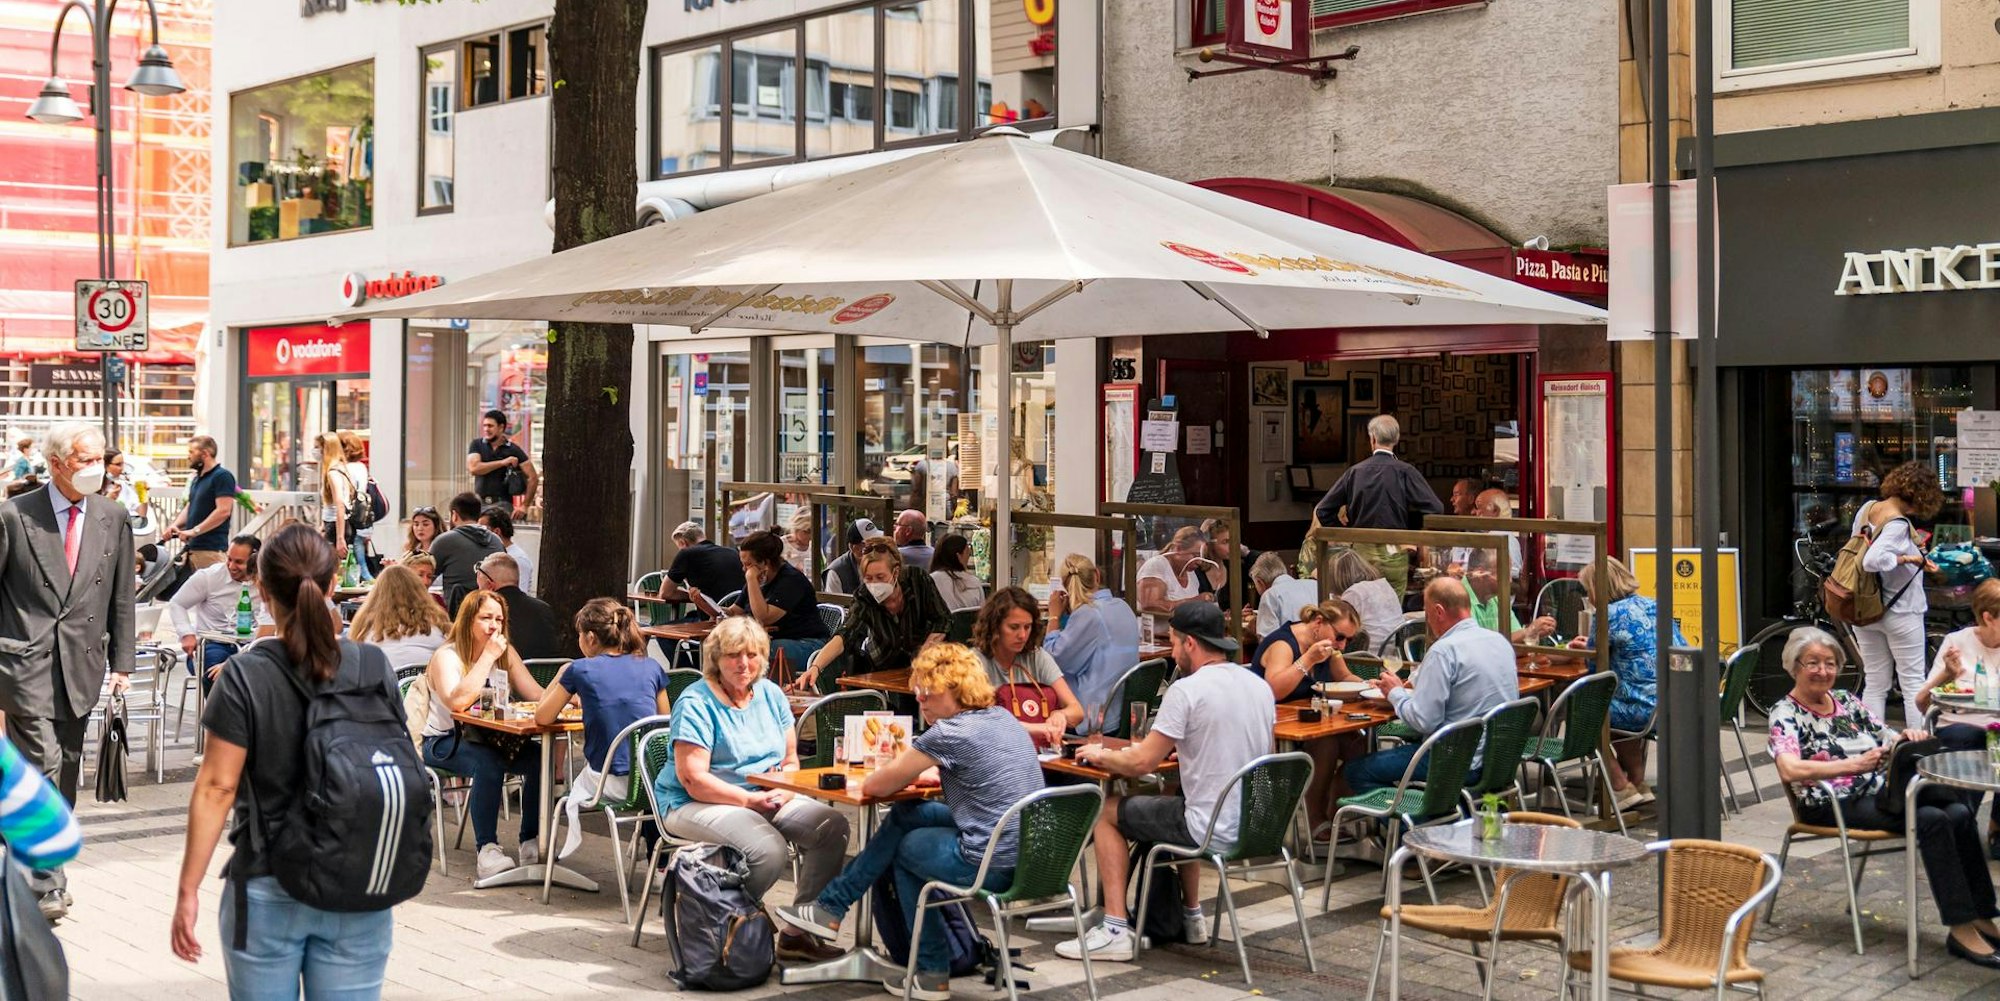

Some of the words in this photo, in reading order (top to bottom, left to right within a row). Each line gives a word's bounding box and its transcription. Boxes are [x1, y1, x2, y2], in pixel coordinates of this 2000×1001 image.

[1516, 257, 1549, 279] Pizza,
[1551, 260, 1581, 281] Pasta
[1583, 267, 1589, 281] e
[1834, 243, 2000, 295] ANKE
[365, 271, 441, 299] vodafone
[99, 299, 126, 319] 30
[291, 339, 342, 358] vodafone
